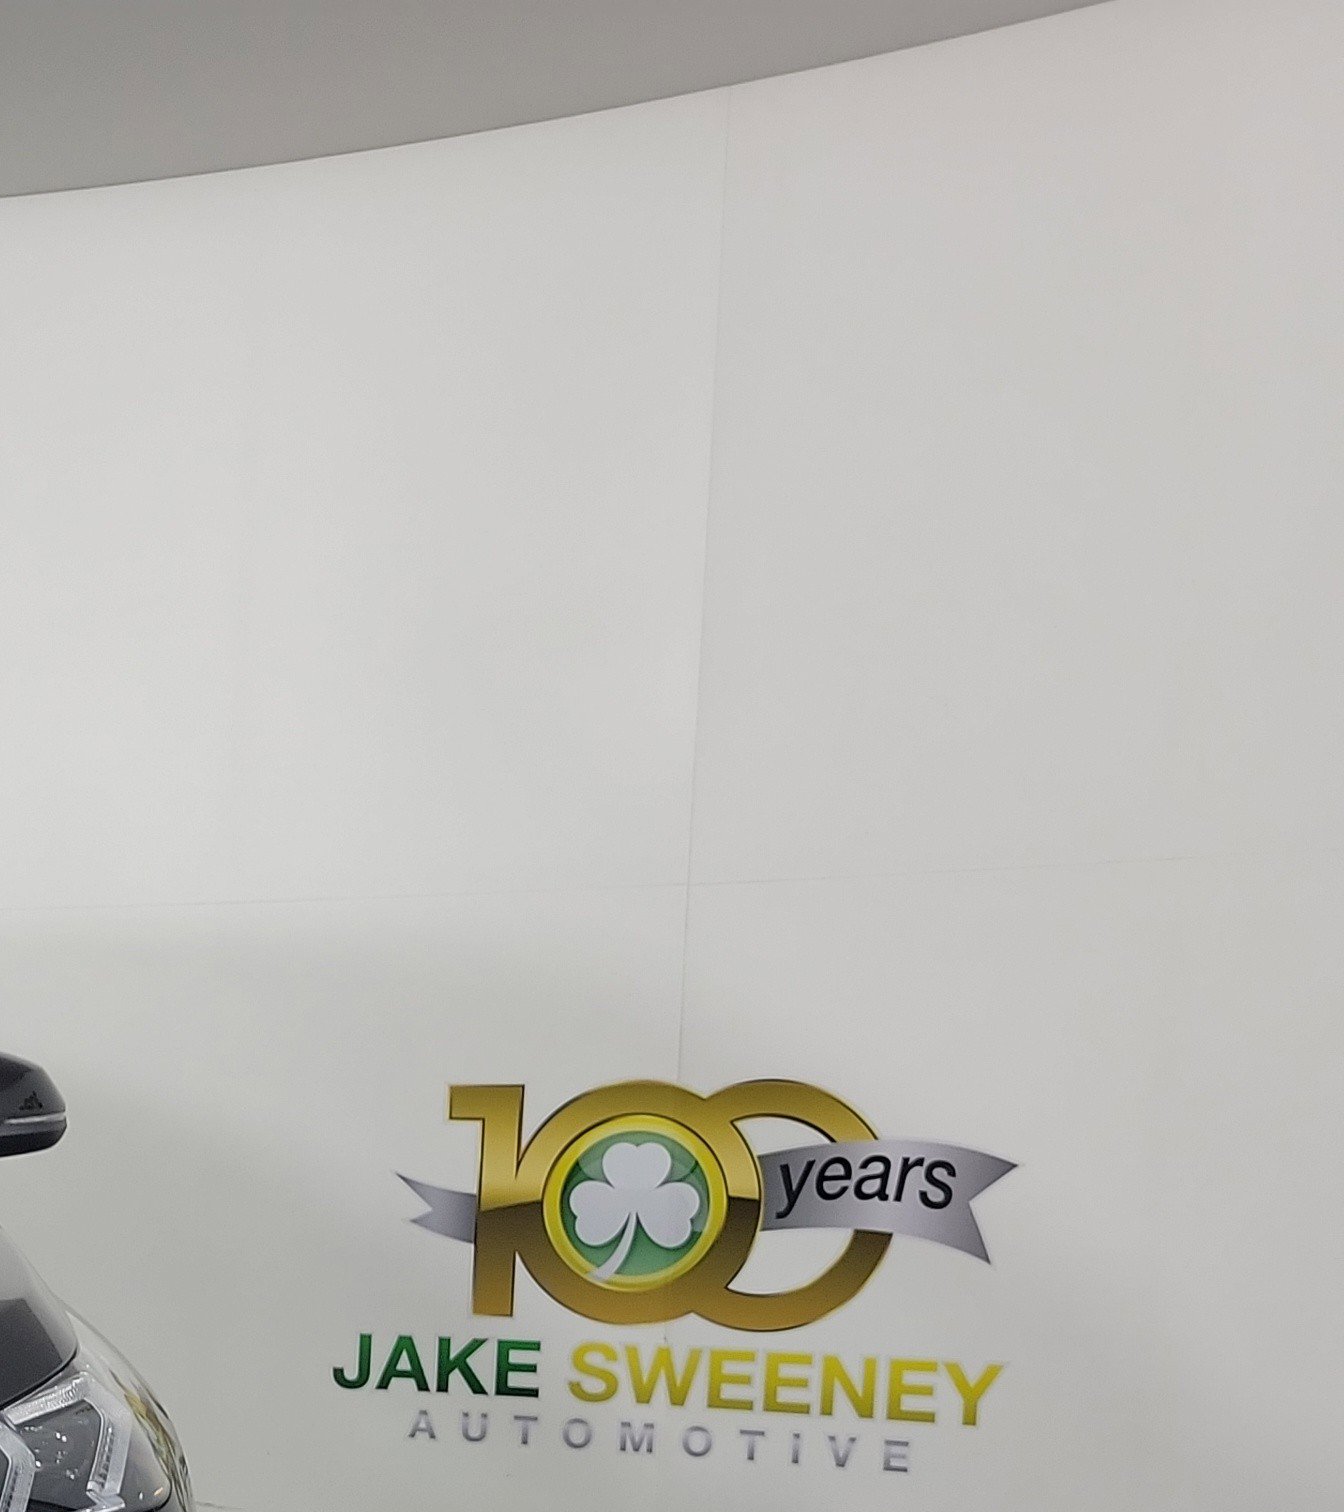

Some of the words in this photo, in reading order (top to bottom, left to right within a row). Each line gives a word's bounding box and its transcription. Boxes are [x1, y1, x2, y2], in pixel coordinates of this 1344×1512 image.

[775, 1152, 957, 1220] years
[332, 1332, 542, 1399] JAKE
[567, 1341, 1004, 1427] SWEENEY
[407, 1408, 911, 1473] AUTOMOTIVE
